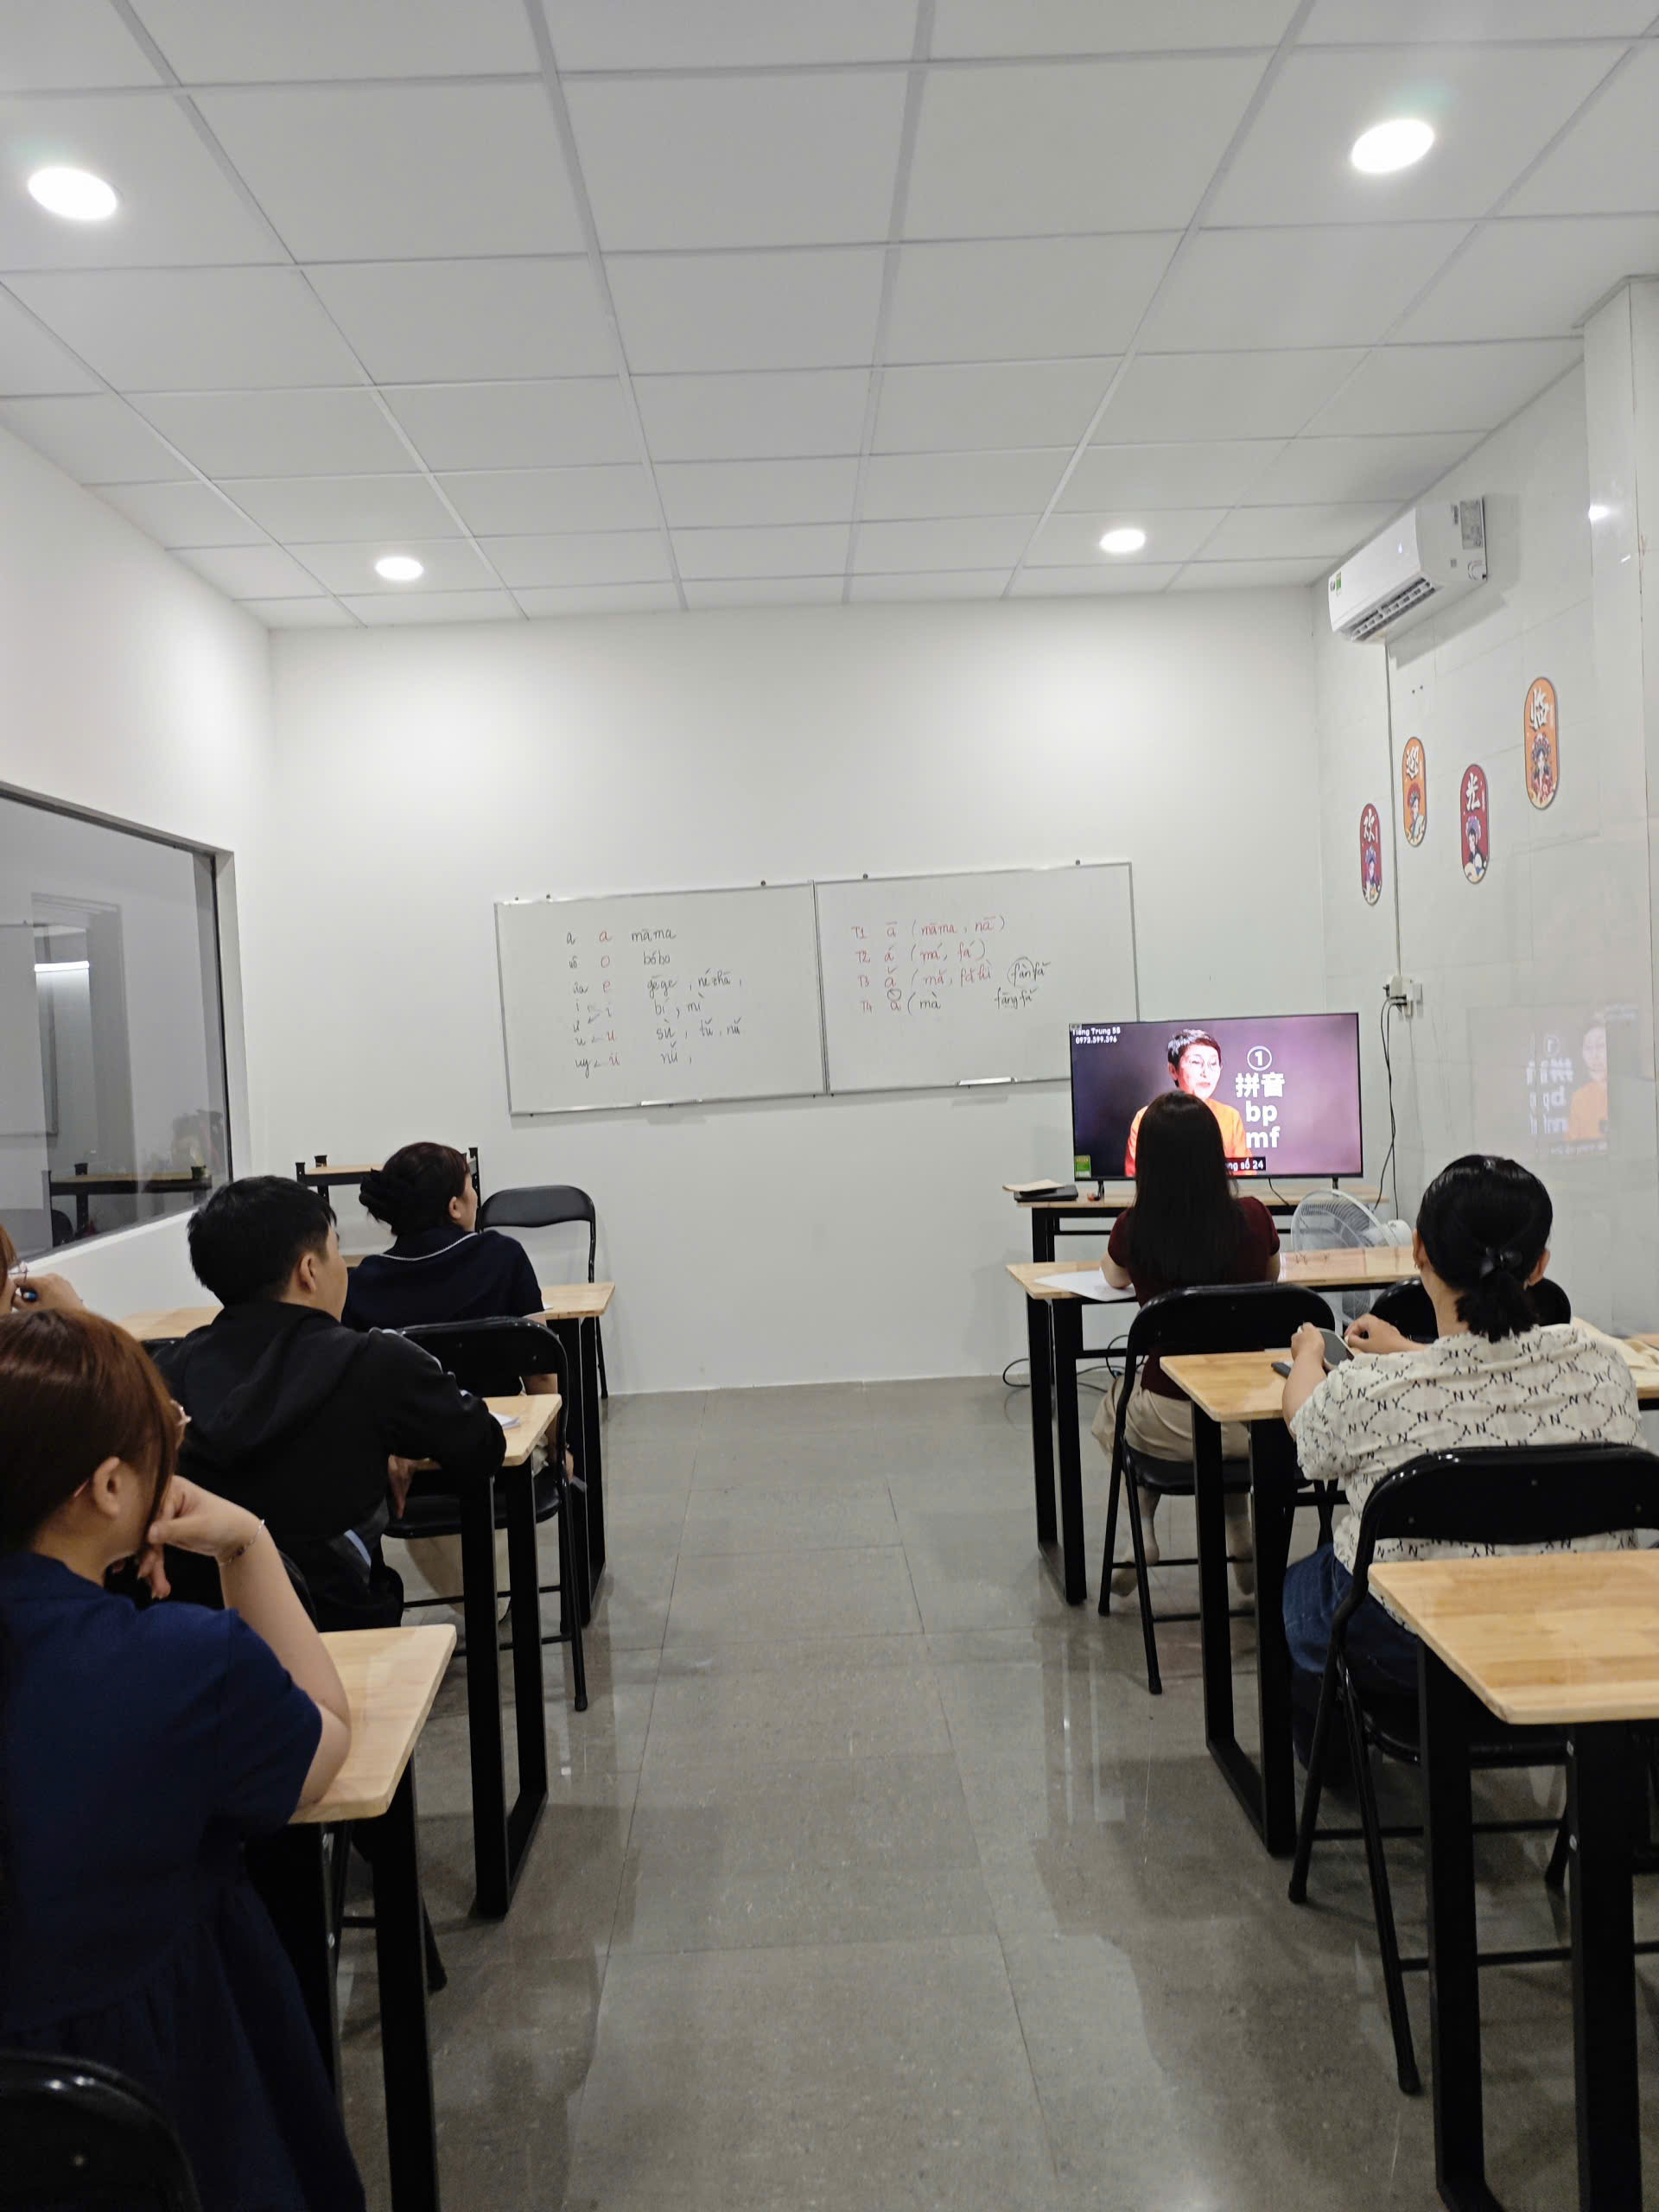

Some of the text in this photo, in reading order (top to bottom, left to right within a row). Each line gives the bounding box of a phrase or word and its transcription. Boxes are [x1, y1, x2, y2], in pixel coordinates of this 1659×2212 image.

[1466, 772, 1481, 810] 光
[599, 931, 613, 944] a
[632, 928, 677, 943] māma
[851, 926, 868, 940] T1
[886, 921, 899, 938] ā
[855, 950, 871, 963] T2
[884, 943, 896, 963] á
[857, 976, 871, 988] T3
[884, 967, 899, 988] ǎ
[861, 1000, 874, 1013] T4
[1090, 1027, 1111, 1036] Trung
[1235, 1071, 1285, 1097] 拼音
[1245, 1100, 1278, 1127] bp
[1245, 1126, 1281, 1148] mf
[1252, 1159, 1264, 1170] 24
[1447, 1348, 1472, 1358] NY
[1412, 1378, 1436, 1389] NY
[1490, 1371, 1513, 1384] NY
[1346, 1388, 1367, 1401] NY
[1452, 1389, 1478, 1402] NY
[1528, 1382, 1550, 1396] NY
[1377, 1397, 1400, 1412] NY
[1569, 1391, 1592, 1405] NY
[1417, 1410, 1444, 1423] NY
[1538, 1414, 1560, 1427] NY
[1349, 1421, 1369, 1434] NY
[1462, 1421, 1486, 1436] NY
